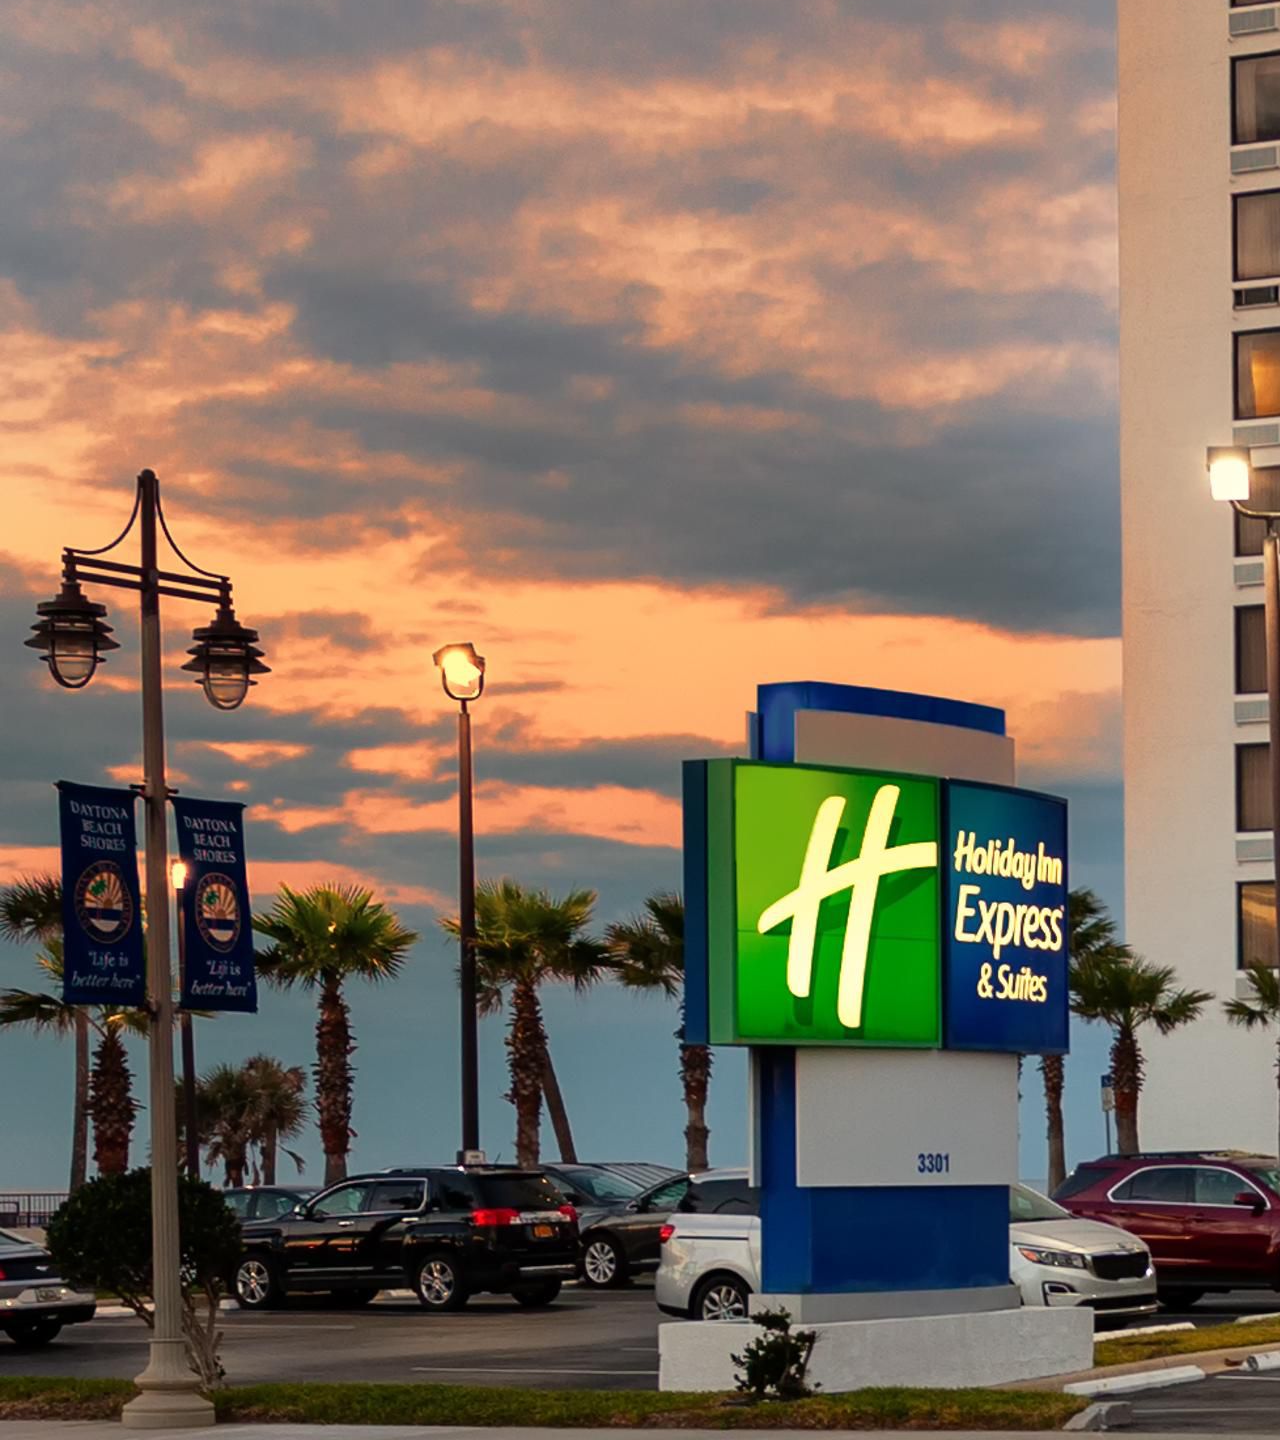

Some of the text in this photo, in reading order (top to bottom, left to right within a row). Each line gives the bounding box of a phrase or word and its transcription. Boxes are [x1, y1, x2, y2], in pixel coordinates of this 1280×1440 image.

[70, 800, 129, 819] DAYTONA
[82, 819, 122, 835] BEACH
[183, 815, 237, 832] DAYTONA
[80, 834, 127, 851] SHORES
[193, 833, 231, 848] BEACH
[193, 848, 237, 864] SHORES
[953, 830, 1063, 891] Holiday Inn
[757, 783, 937, 1029] H
[954, 884, 1063, 960] Express
[118, 952, 129, 967] is
[229, 962, 241, 976] is
[71, 970, 110, 988] better
[190, 979, 225, 996] better
[977, 962, 1048, 1003] & Suites
[917, 1152, 950, 1174] 3301
